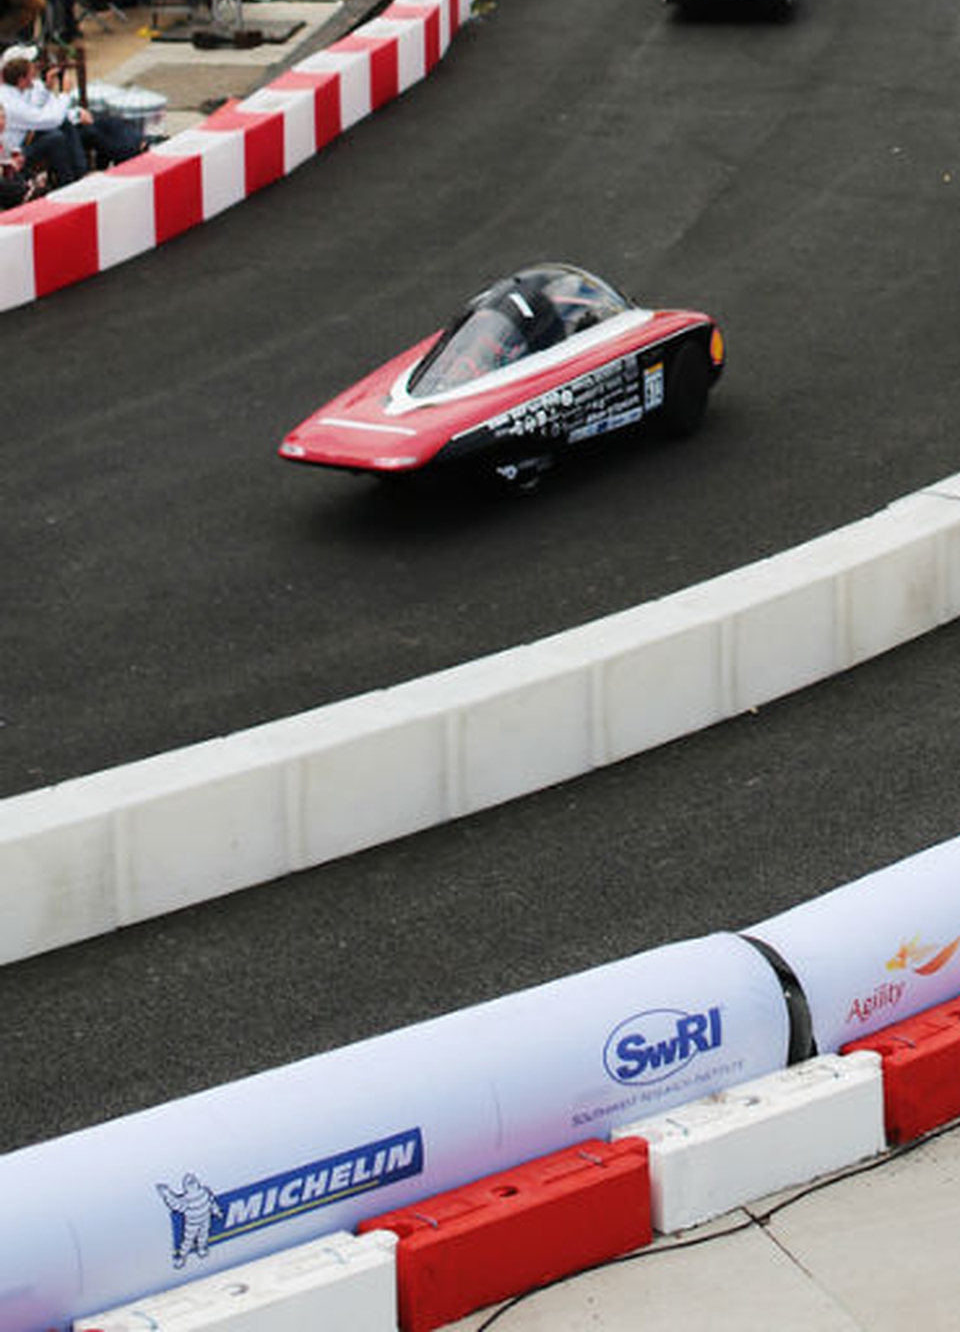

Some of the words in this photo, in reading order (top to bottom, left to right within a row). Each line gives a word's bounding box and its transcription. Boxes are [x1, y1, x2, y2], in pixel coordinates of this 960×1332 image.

[846, 980, 907, 1023] Agility
[615, 1007, 722, 1080] SwRI
[223, 1140, 416, 1229] MICHELIN
